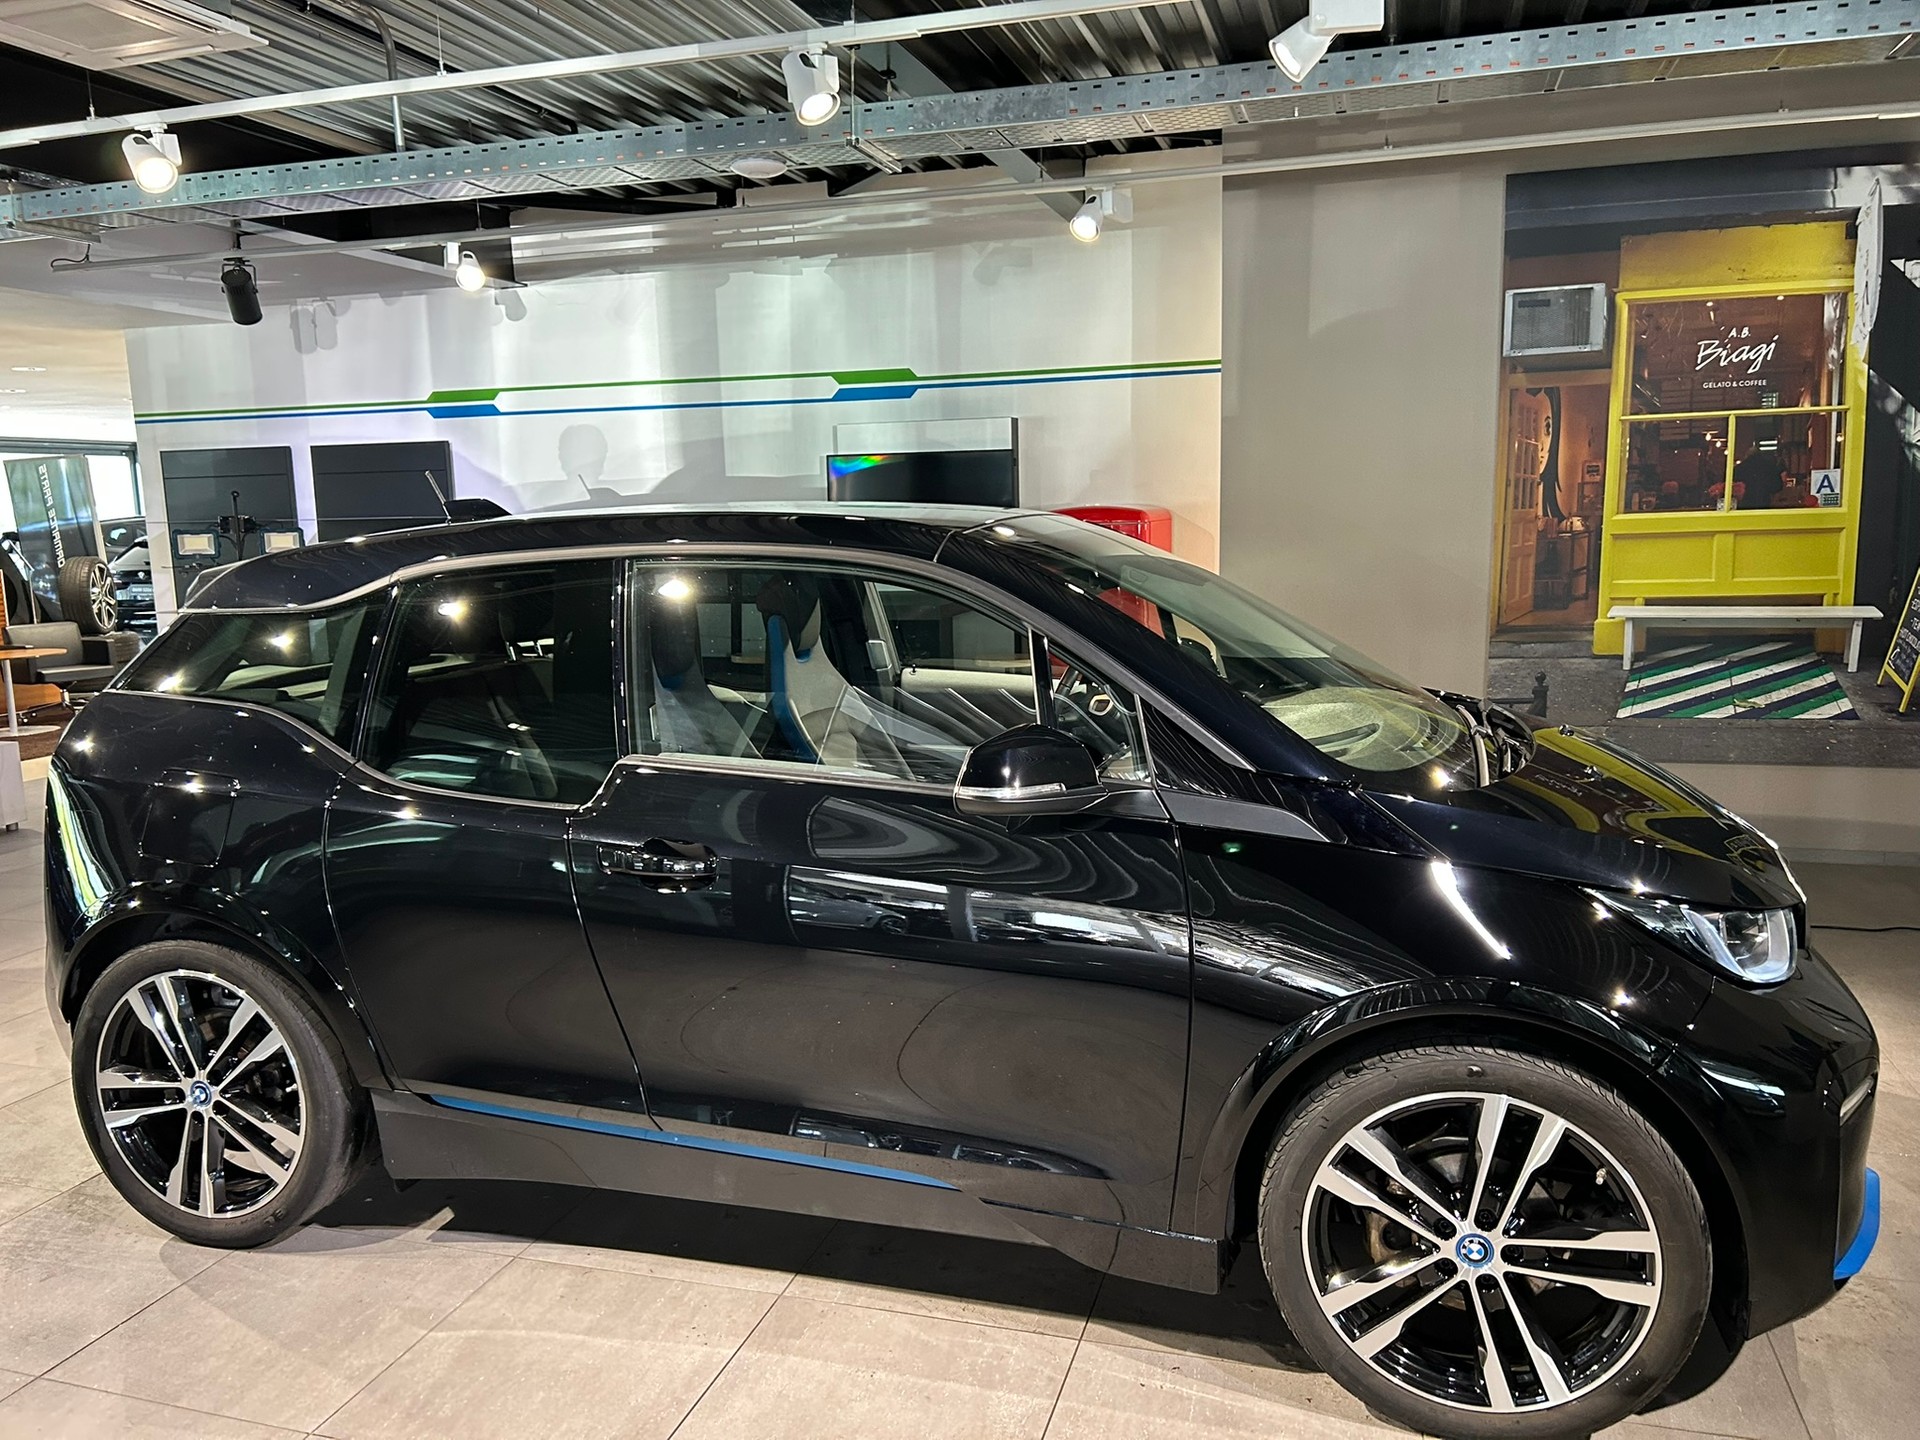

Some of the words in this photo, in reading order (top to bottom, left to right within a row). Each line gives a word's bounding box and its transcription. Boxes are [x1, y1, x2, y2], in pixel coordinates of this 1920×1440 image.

[1728, 326, 1751, 338] A.B.
[1695, 335, 1779, 374] Biagi
[1702, 381, 1731, 389] GELATO
[1739, 379, 1767, 387] COFFEE
[1815, 474, 1836, 494] A
